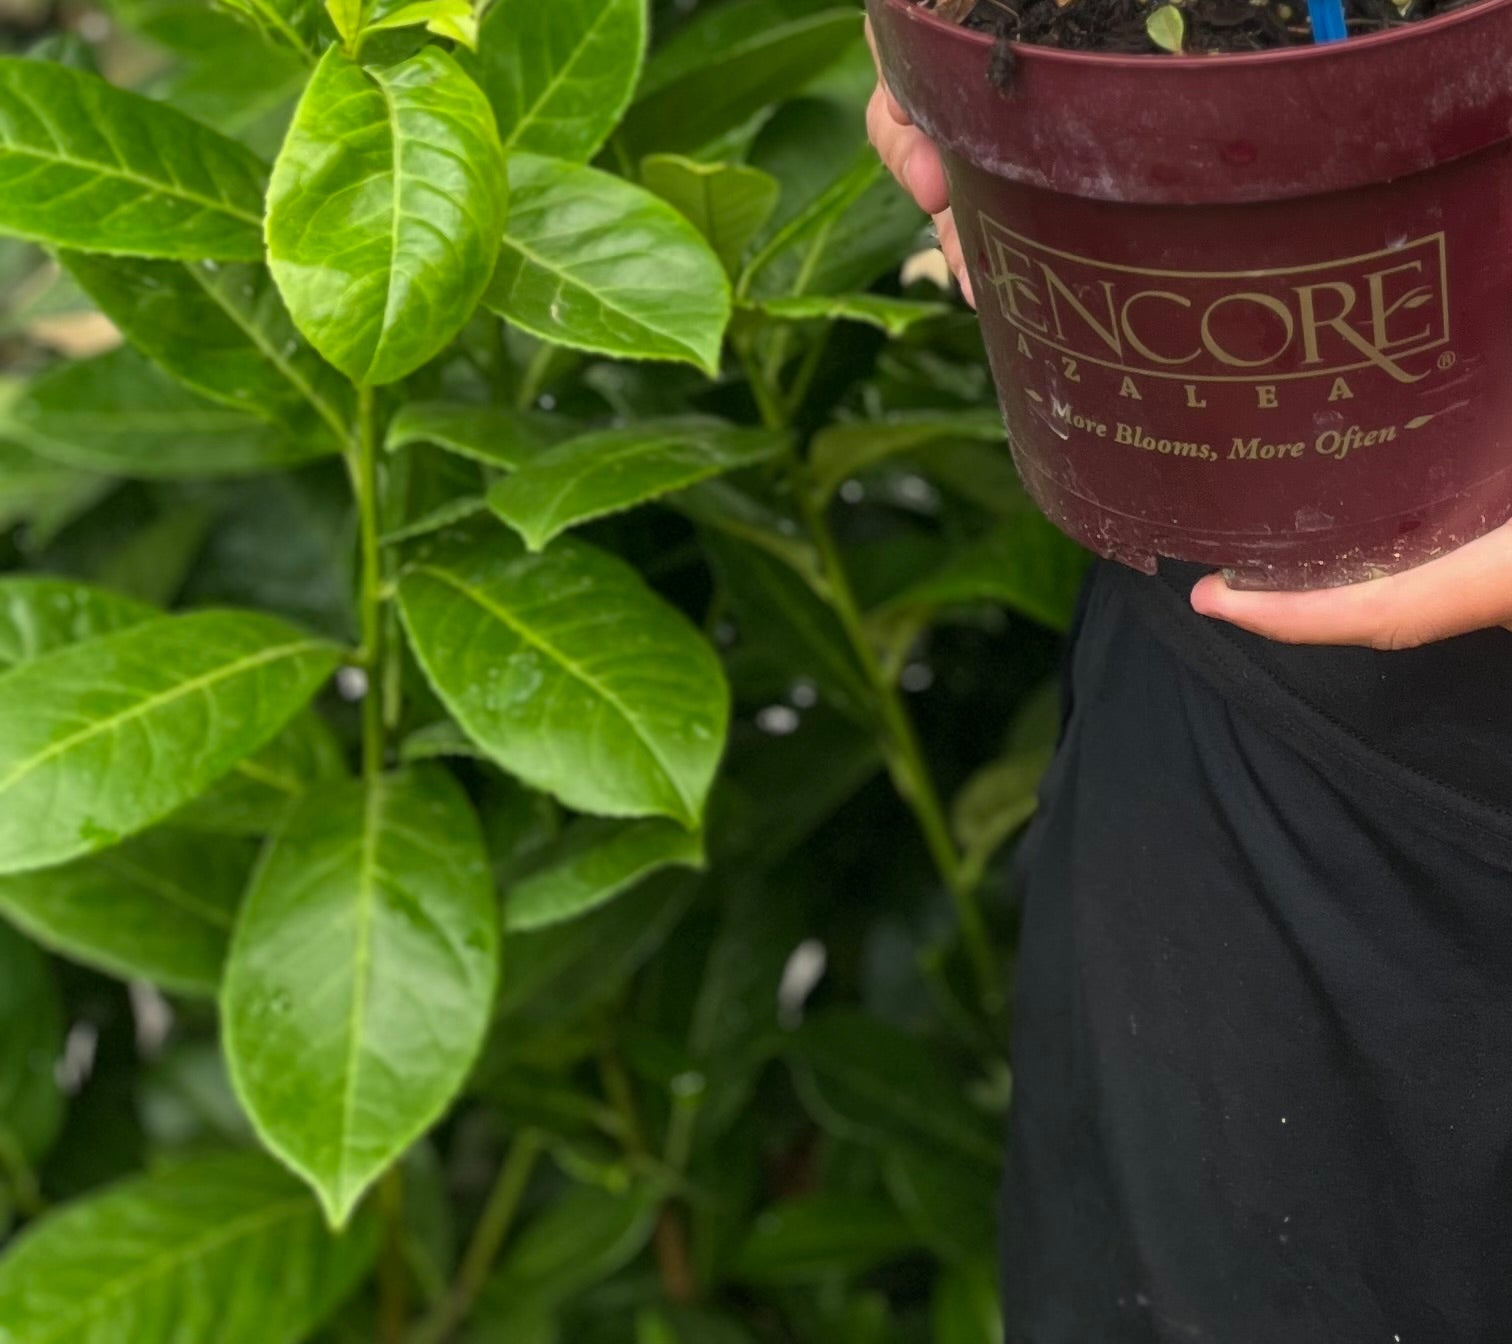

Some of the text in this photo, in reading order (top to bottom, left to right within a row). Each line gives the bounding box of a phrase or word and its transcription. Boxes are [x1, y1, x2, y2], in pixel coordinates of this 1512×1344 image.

[1016, 332, 1355, 409] AZALEA
[1050, 398, 1397, 462] More Blooms, More Often
